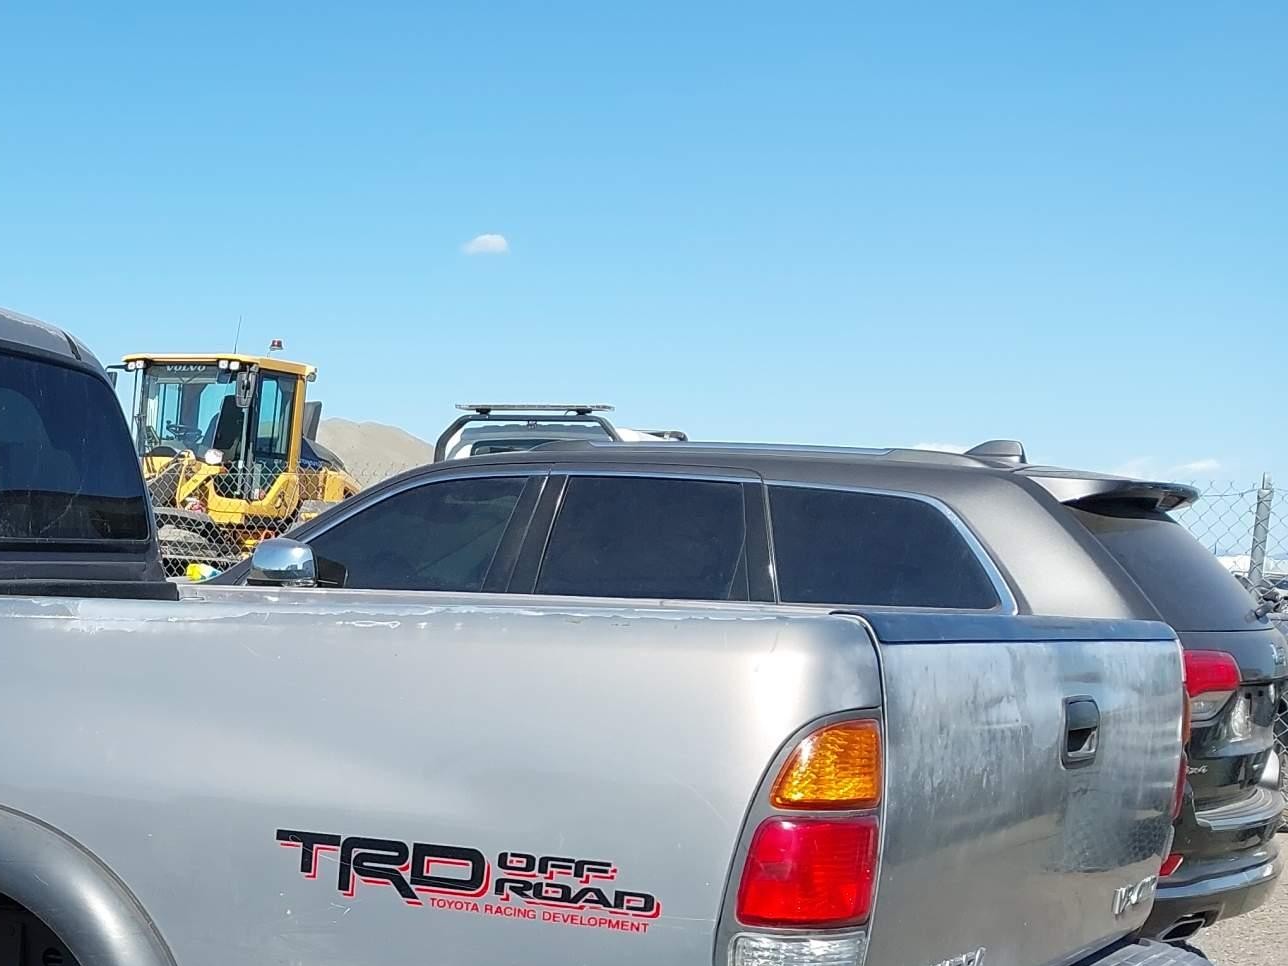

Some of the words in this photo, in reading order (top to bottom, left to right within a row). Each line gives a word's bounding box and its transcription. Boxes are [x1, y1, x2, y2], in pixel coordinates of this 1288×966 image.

[166, 364, 206, 372] VOLVO
[276, 828, 491, 906] TRD
[496, 851, 618, 884] OFF
[428, 897, 480, 914] TOYOTA
[484, 903, 537, 921] RACING
[542, 910, 650, 934] DEVELOPMENT
[494, 877, 662, 919] ROAD
